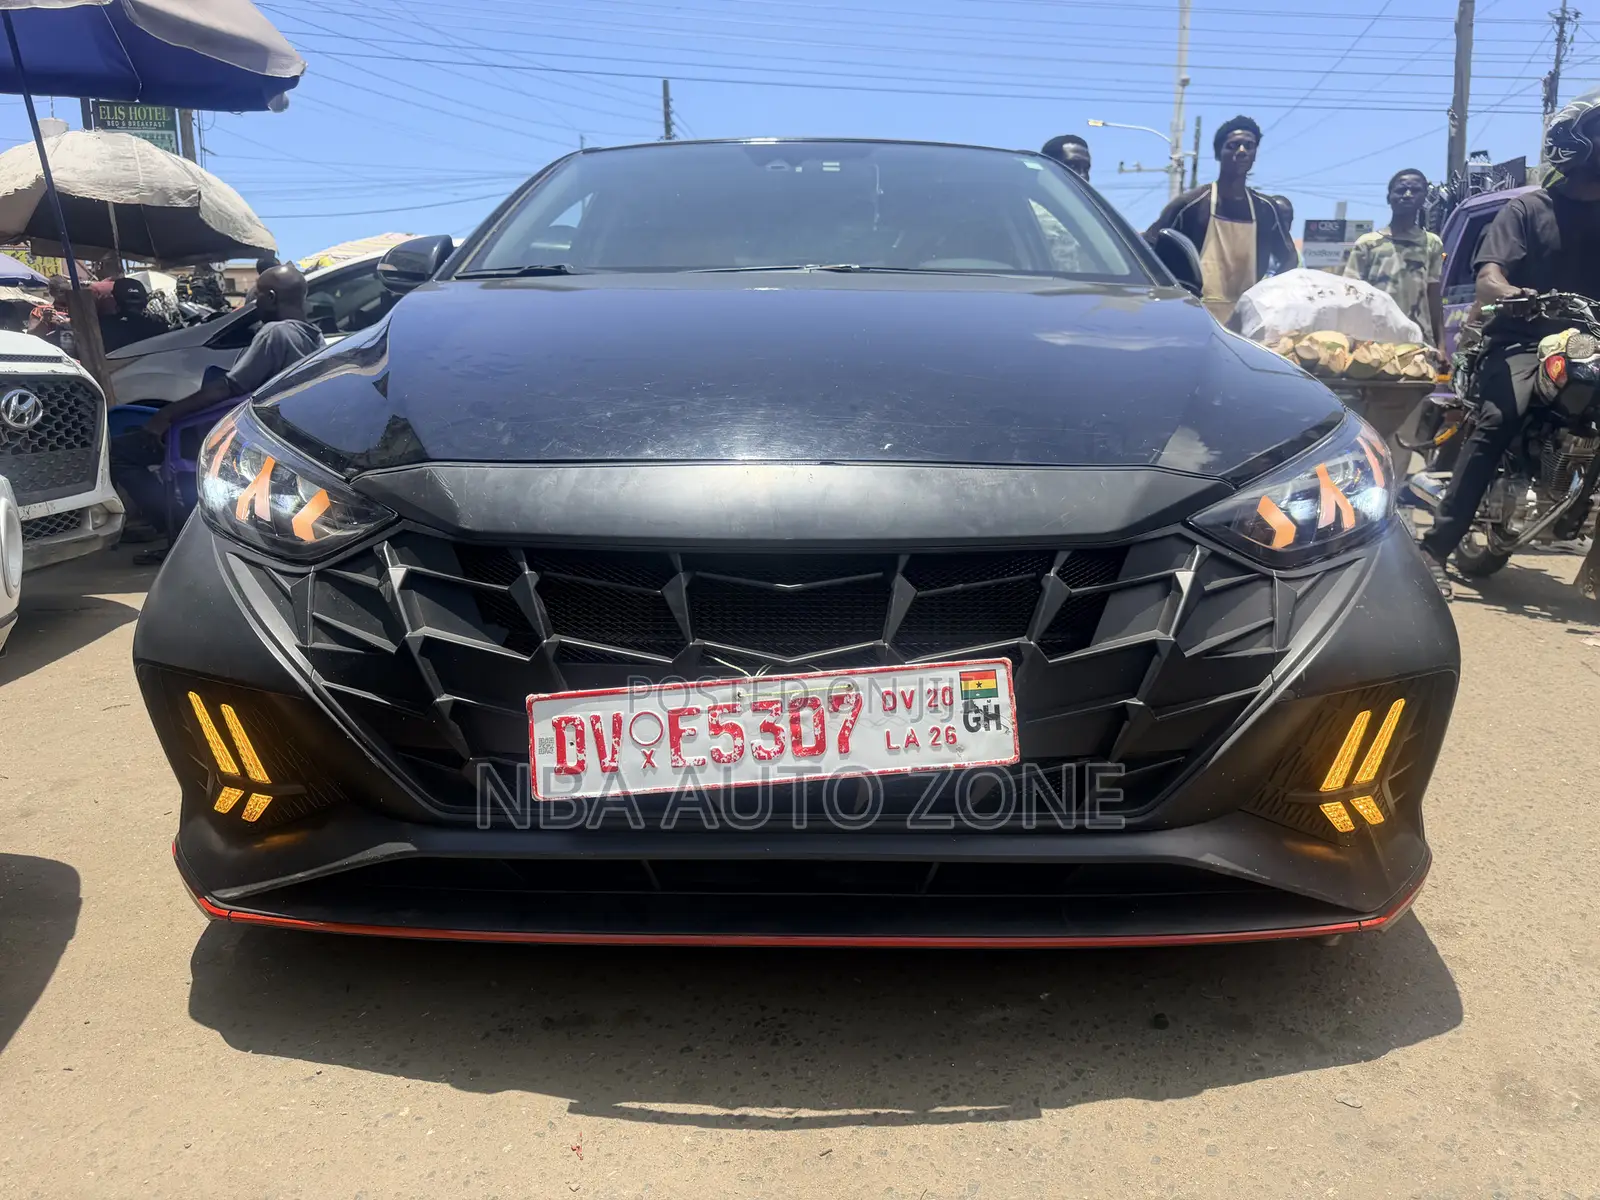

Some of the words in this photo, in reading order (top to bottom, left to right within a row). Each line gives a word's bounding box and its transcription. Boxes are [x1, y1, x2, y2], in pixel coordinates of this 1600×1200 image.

[99, 106, 126, 120] ELIS
[129, 106, 170, 121] HOTEL
[881, 688, 916, 712] DV
[926, 685, 955, 708] 20
[962, 701, 1002, 733] GH
[551, 710, 625, 776] DV
[666, 692, 864, 768] E5307
[885, 728, 921, 751] LA
[928, 725, 958, 747] 26
